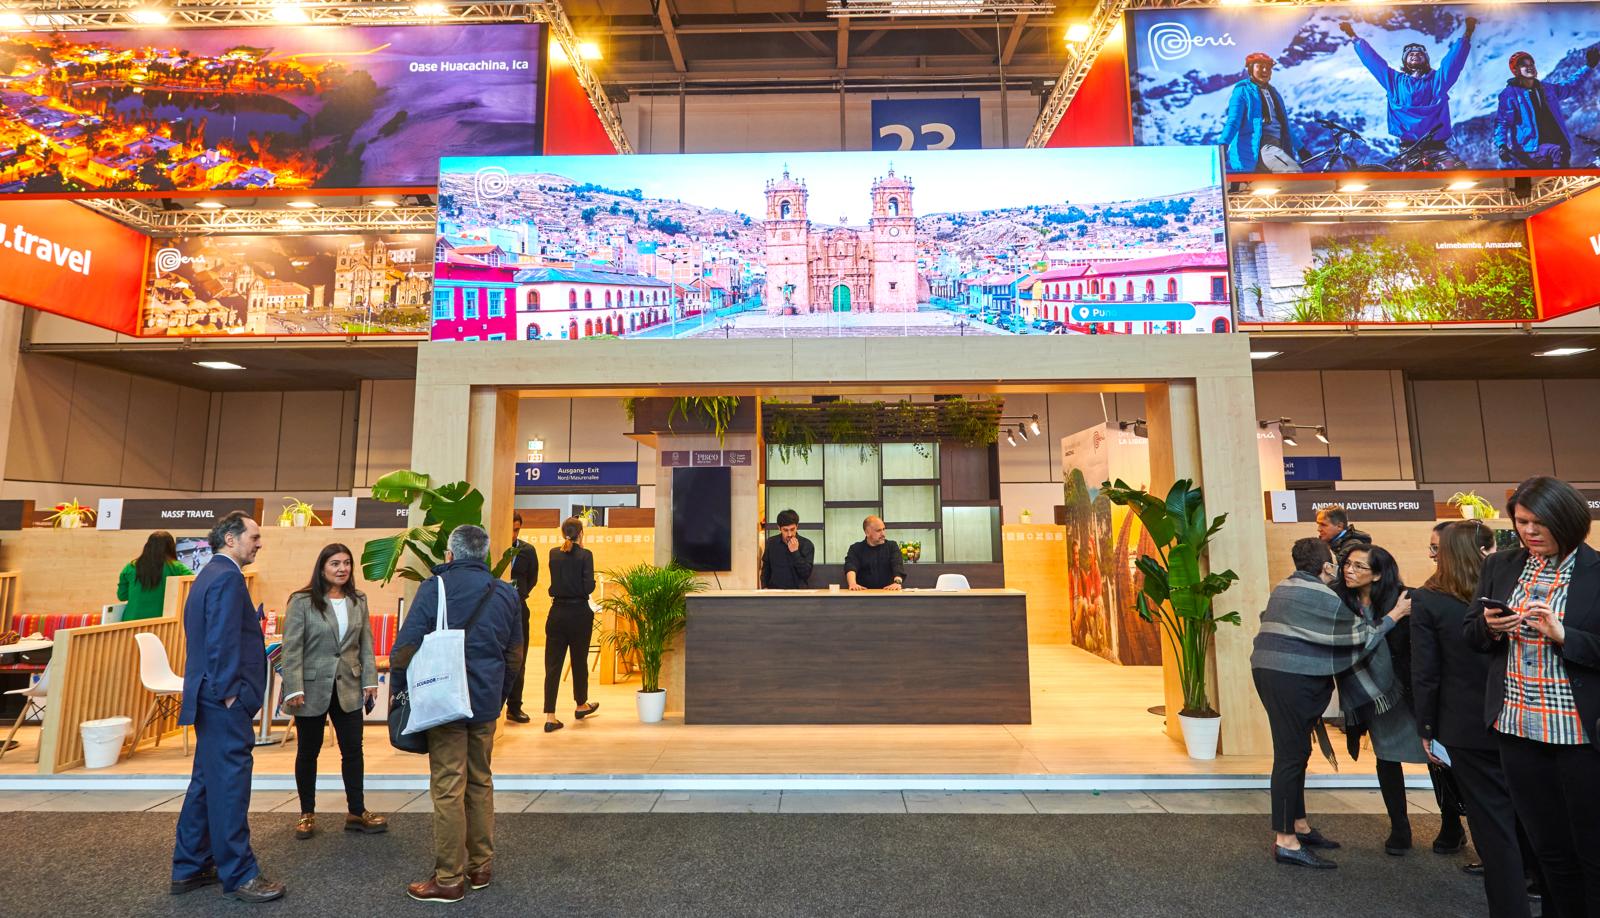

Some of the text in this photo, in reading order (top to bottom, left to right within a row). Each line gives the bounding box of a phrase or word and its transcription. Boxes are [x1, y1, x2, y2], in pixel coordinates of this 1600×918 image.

[1147, 21, 1236, 72] Perú
[409, 60, 529, 72] Oase Huacachina, Ica
[1485, 241, 1523, 249] Amazonas
[155, 247, 206, 279] Perú
[524, 467, 541, 481] 19
[1346, 502, 1398, 510] ADVENTURES
[1398, 502, 1420, 510] PERU
[105, 511, 111, 519] 3
[161, 510, 215, 519] NASSF TRAVEL
[341, 509, 346, 517] 4
